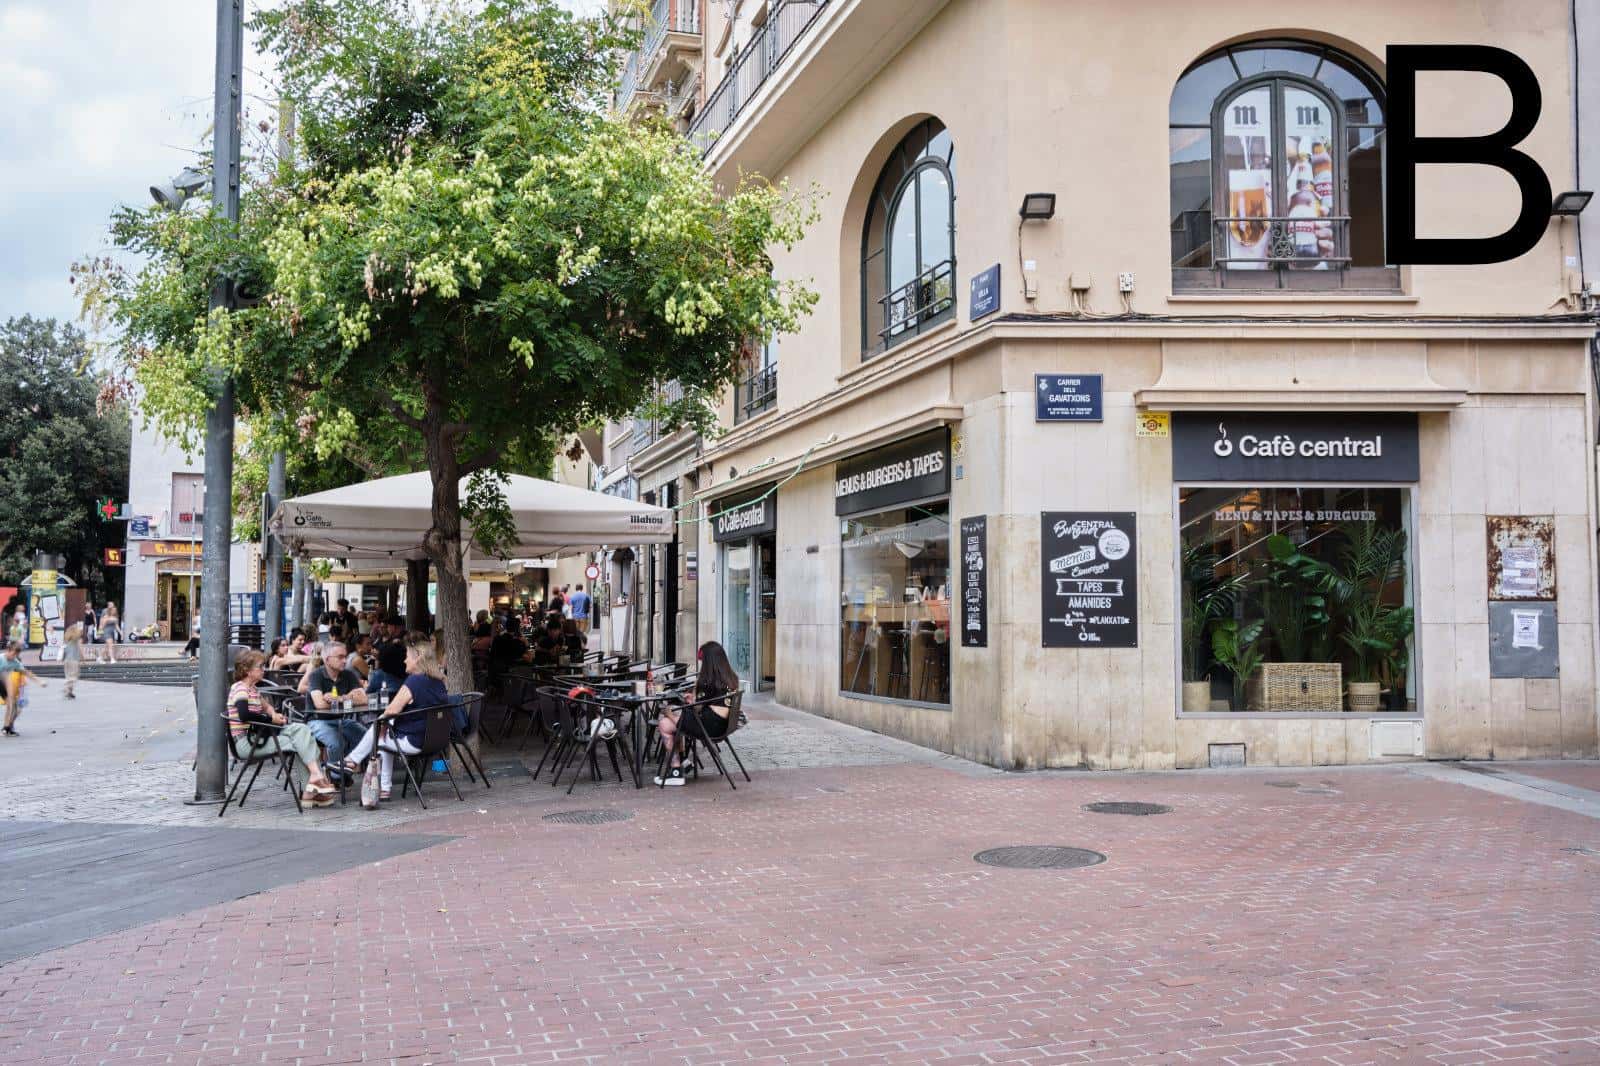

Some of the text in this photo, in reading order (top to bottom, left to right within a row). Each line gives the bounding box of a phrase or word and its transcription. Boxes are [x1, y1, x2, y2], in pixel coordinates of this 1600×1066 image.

[1057, 378, 1081, 386] CARRER
[1239, 435, 1382, 457] Cafè central
[866, 462, 905, 489] BURGERS
[912, 450, 944, 477] TAPES
[1215, 510, 1377, 521] MENU & TAPES & BURGUER
[1074, 520, 1117, 529] CENTRAL
[1077, 582, 1103, 592] TAPES
[1068, 597, 1112, 608] AMANIDES
